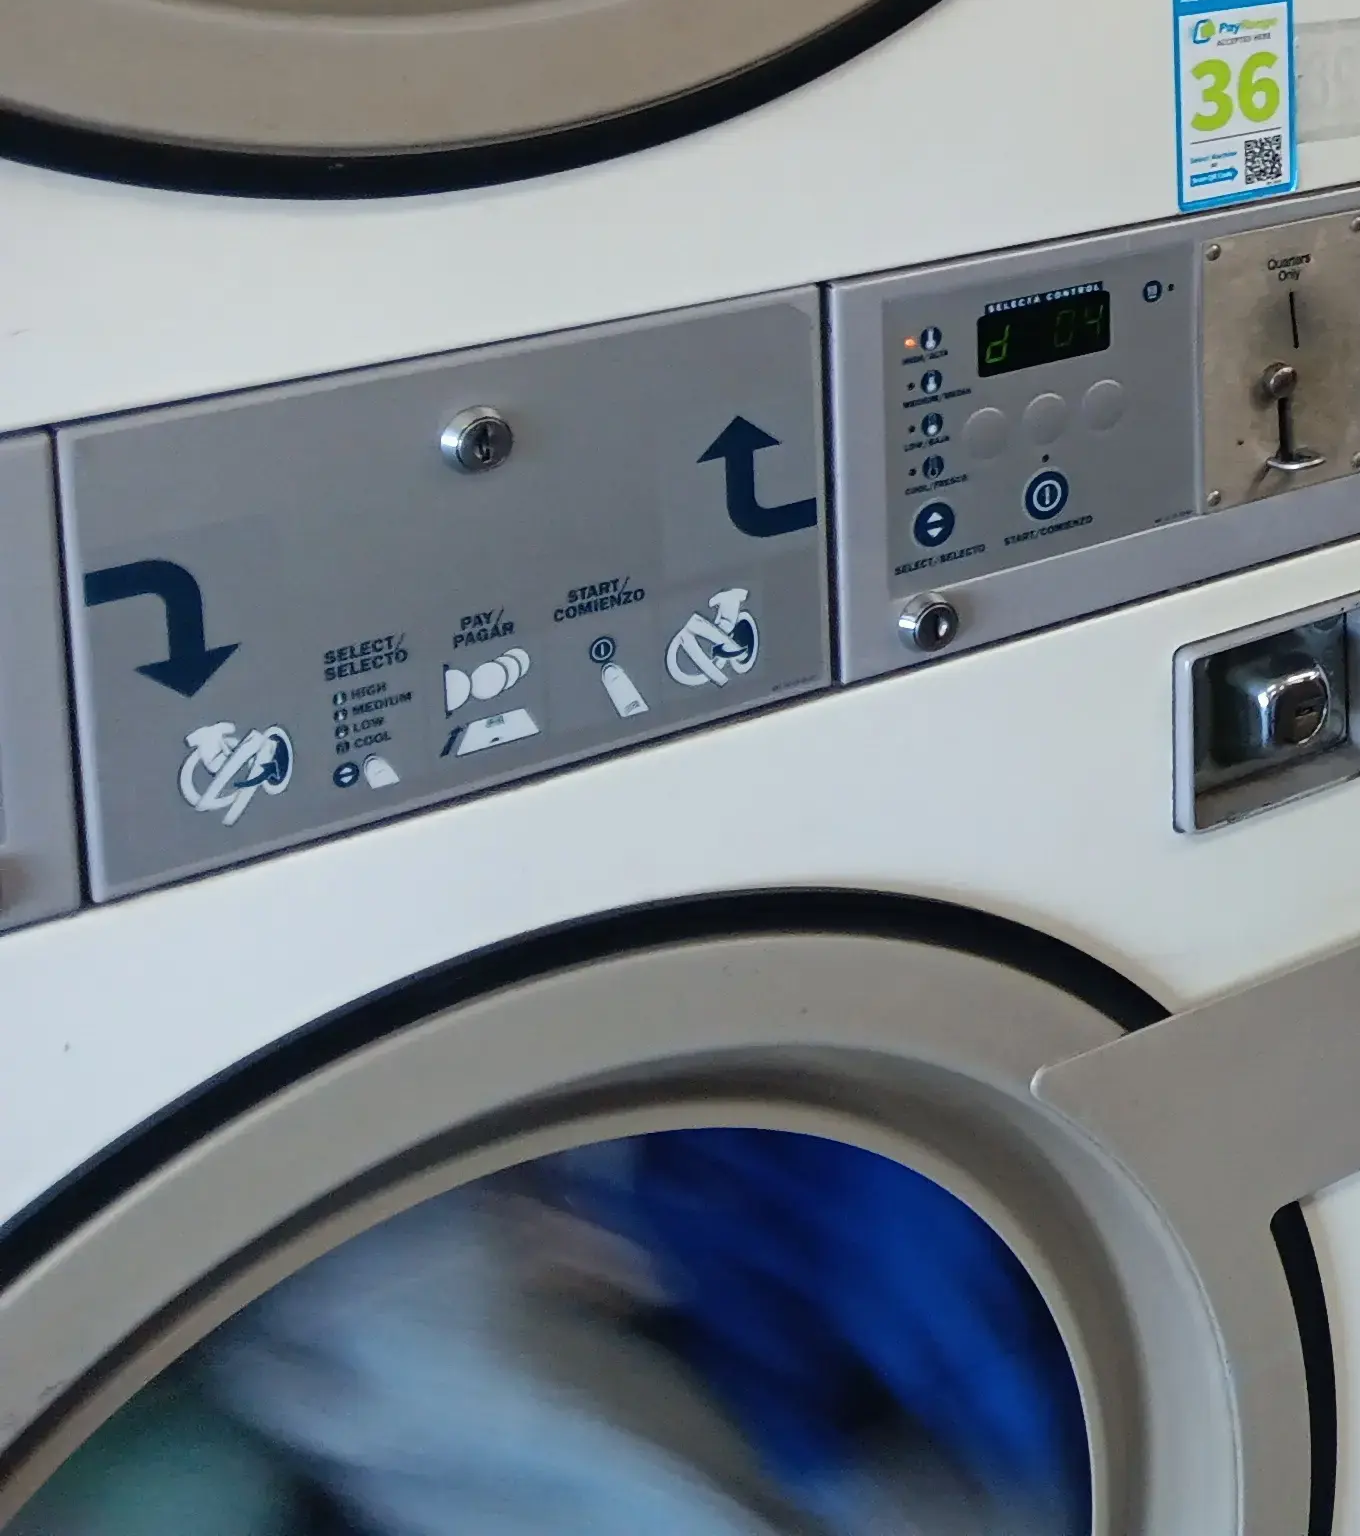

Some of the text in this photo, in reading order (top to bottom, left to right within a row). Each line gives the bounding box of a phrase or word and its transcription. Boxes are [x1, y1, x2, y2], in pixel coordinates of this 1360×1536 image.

[1190, 51, 1280, 132] 36
[1268, 253, 1311, 270] Quarters
[1279, 270, 1301, 281] Only
[1046, 284, 1099, 301] CONTROL
[1004, 514, 1093, 546] START/COMIENZO
[894, 544, 986, 576] SELECT/SELECTO
[568, 576, 630, 603] START/
[554, 588, 645, 622] COMIENZO
[460, 607, 504, 631] PAY/
[453, 621, 515, 649] PAGAR
[324, 632, 406, 665] SELECT/
[324, 649, 408, 681] SELECTO
[351, 681, 387, 700] HIGH
[352, 692, 412, 715] MEDIUM
[353, 717, 385, 733] LOW
[354, 731, 392, 749] COOL
